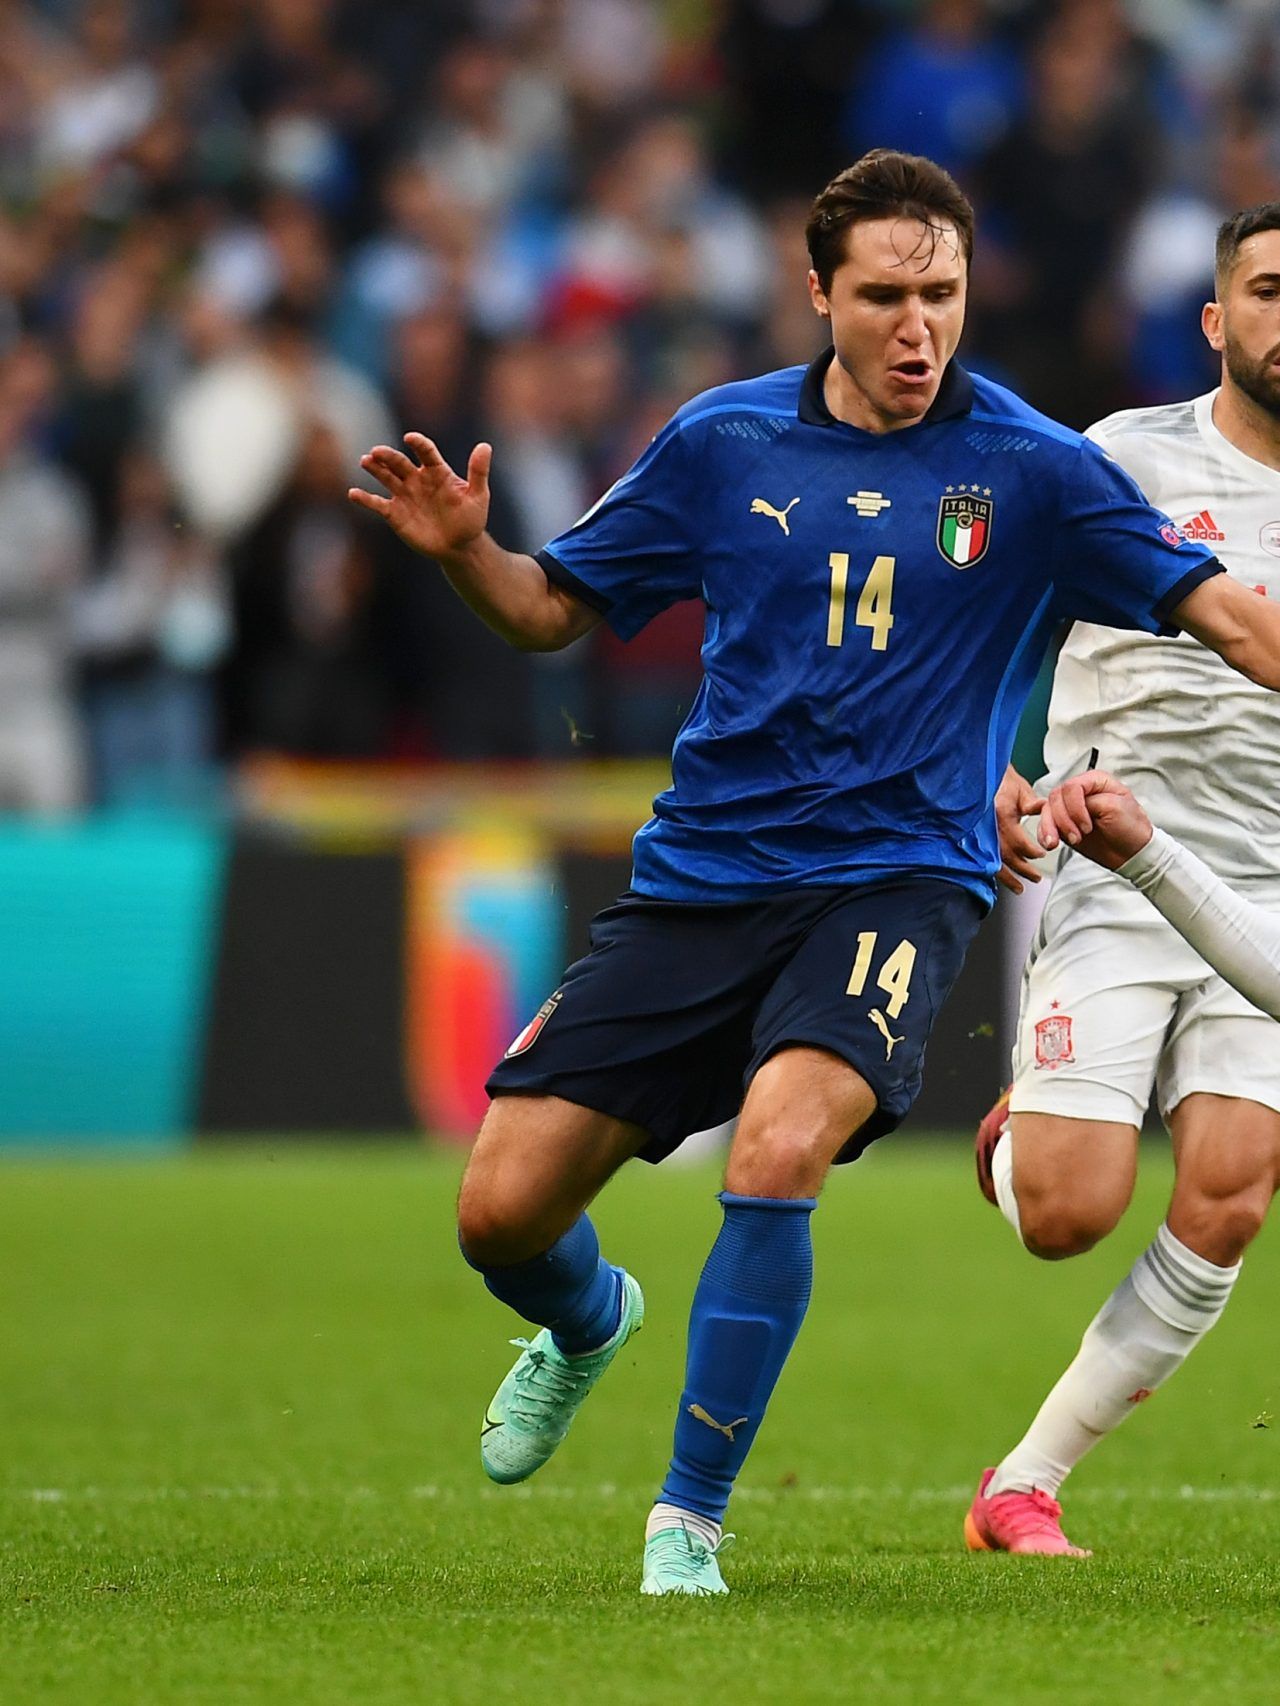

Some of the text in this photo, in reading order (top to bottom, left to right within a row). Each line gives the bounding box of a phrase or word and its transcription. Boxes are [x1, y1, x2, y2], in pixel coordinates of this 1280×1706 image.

[945, 500, 987, 515] ITALIA
[1182, 527, 1226, 541] didas
[827, 552, 896, 651] 14
[846, 931, 917, 1019] 14
